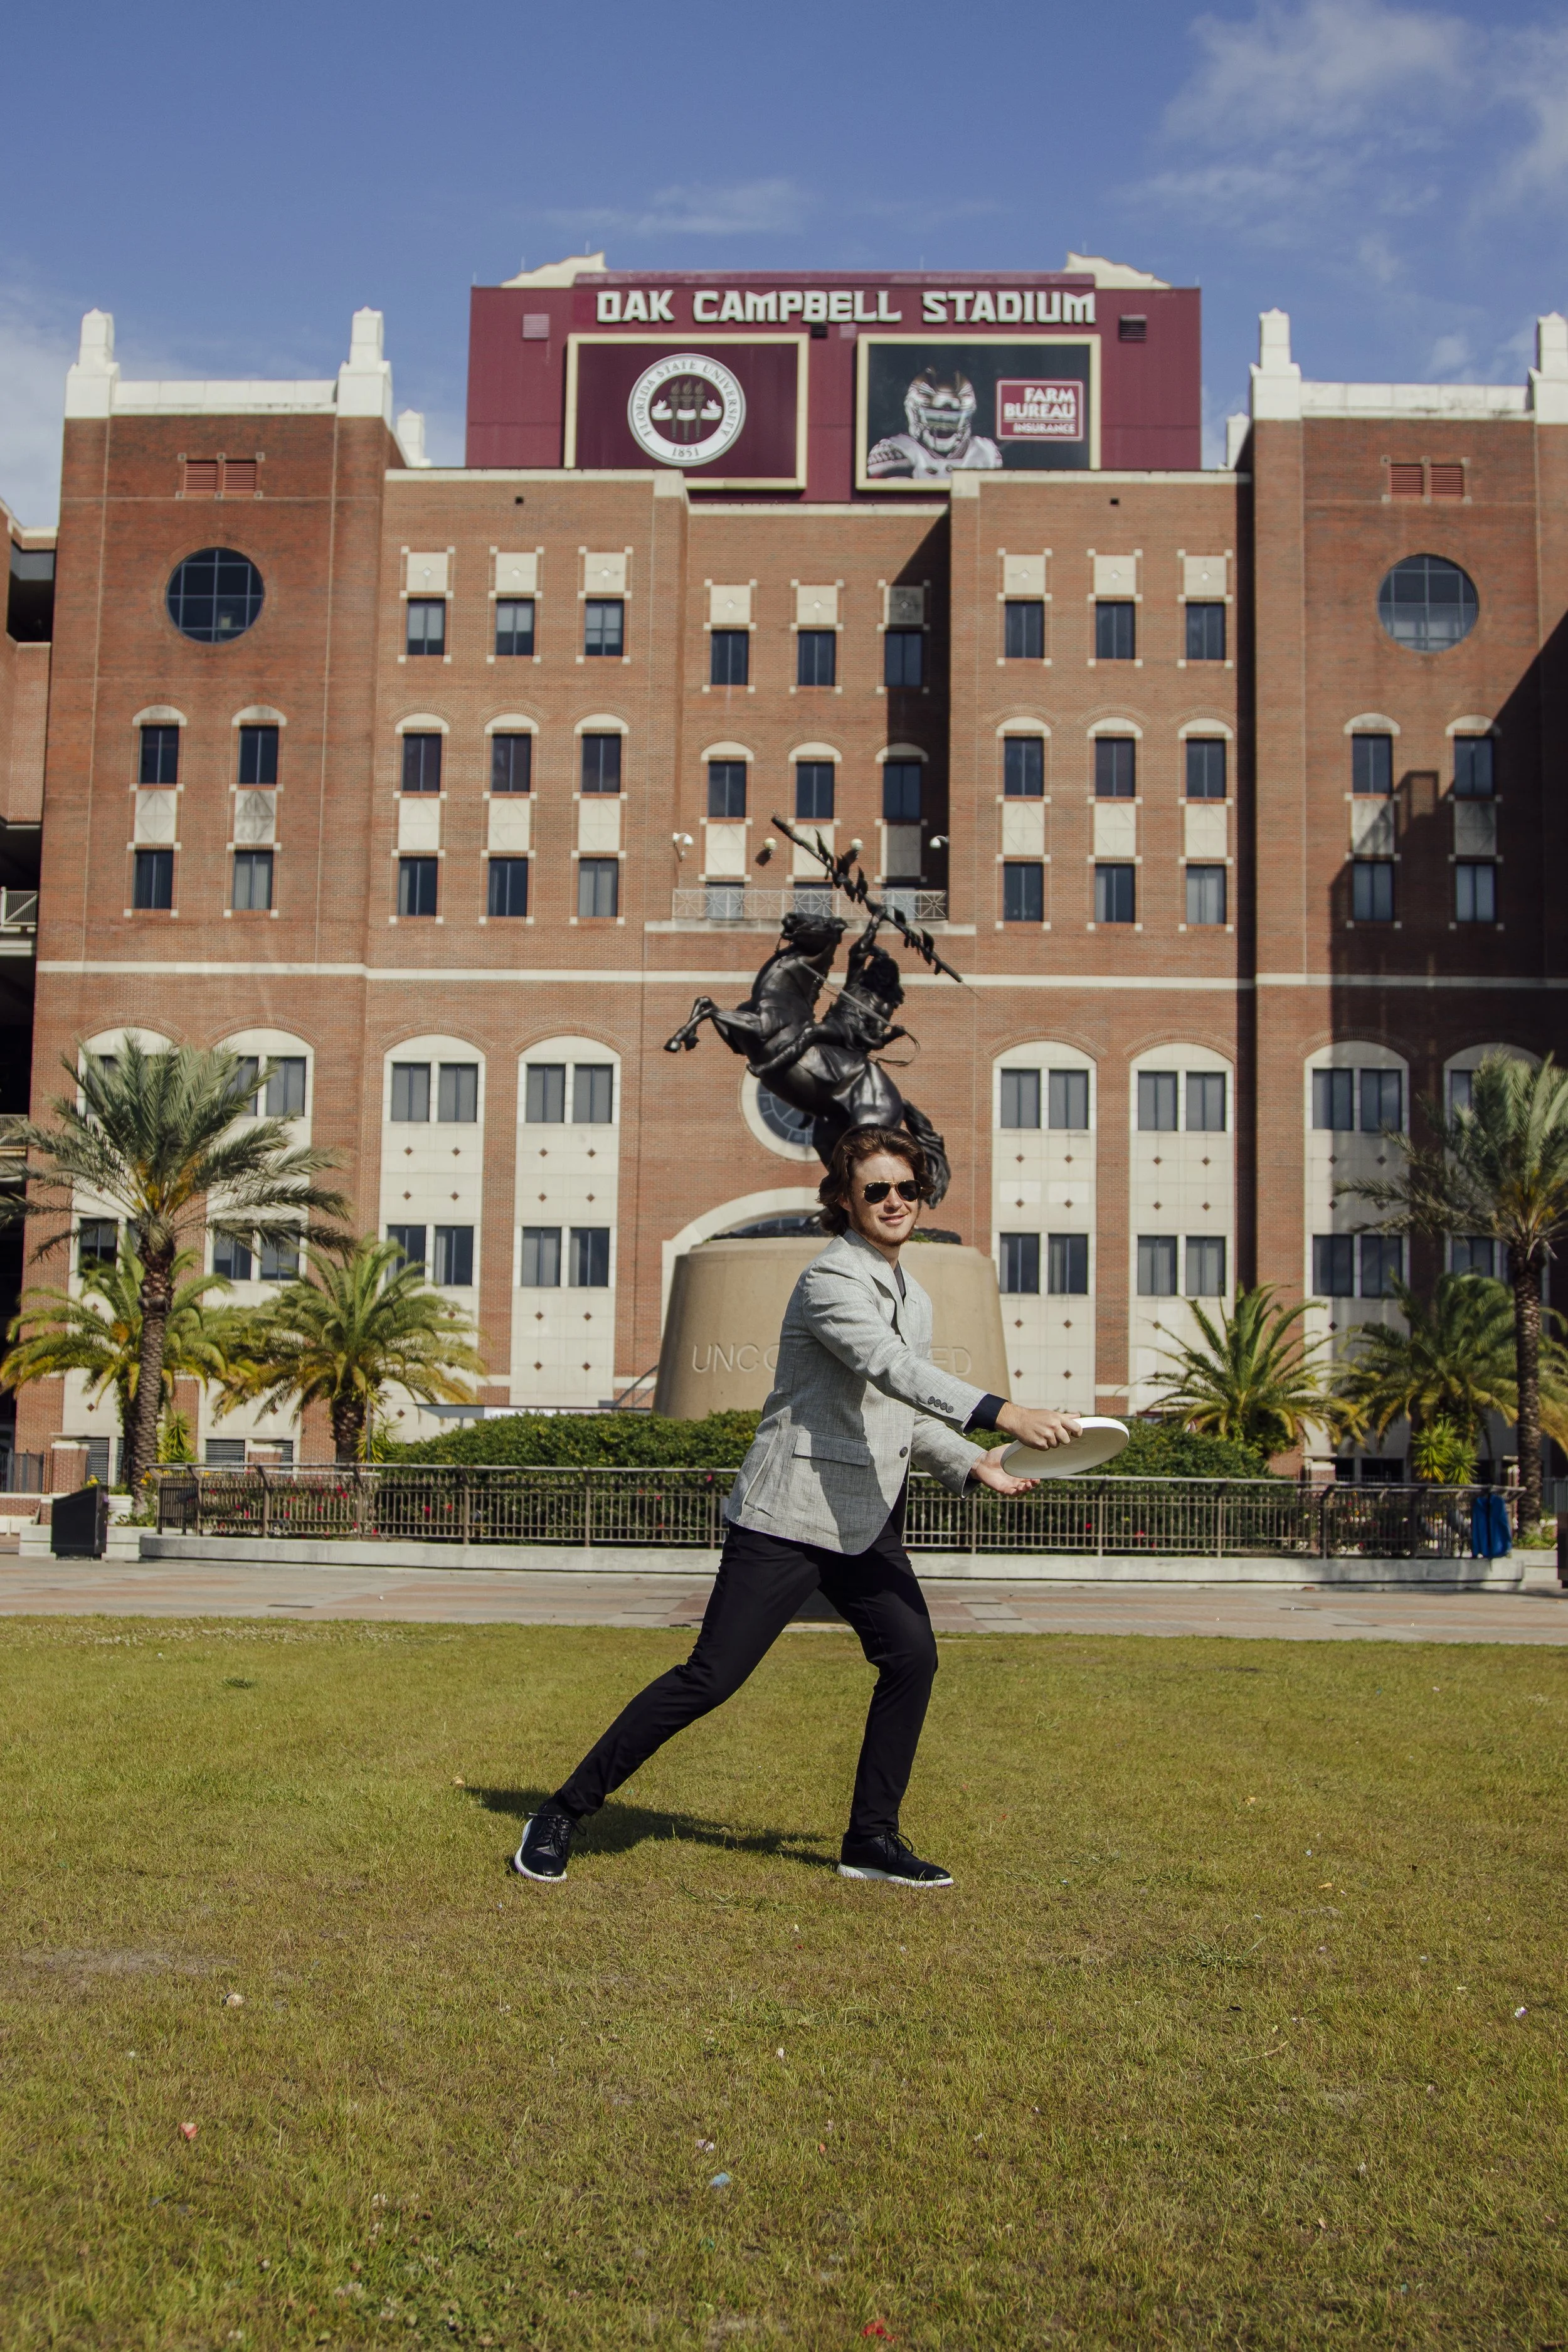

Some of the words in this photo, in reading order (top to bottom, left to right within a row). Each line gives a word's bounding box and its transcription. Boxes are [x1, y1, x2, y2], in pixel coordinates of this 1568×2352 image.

[693, 290, 902, 323] CAMPBELL
[922, 291, 1096, 324] STADIUM
[635, 379, 656, 437] FLORIDA
[656, 360, 696, 378] STATE
[702, 364, 738, 437] UNIVERSITY
[1024, 387, 1076, 403] FARM
[1004, 403, 1076, 418] BUREAU
[1013, 423, 1076, 435] INSURANCE
[672, 447, 699, 457] 1851
